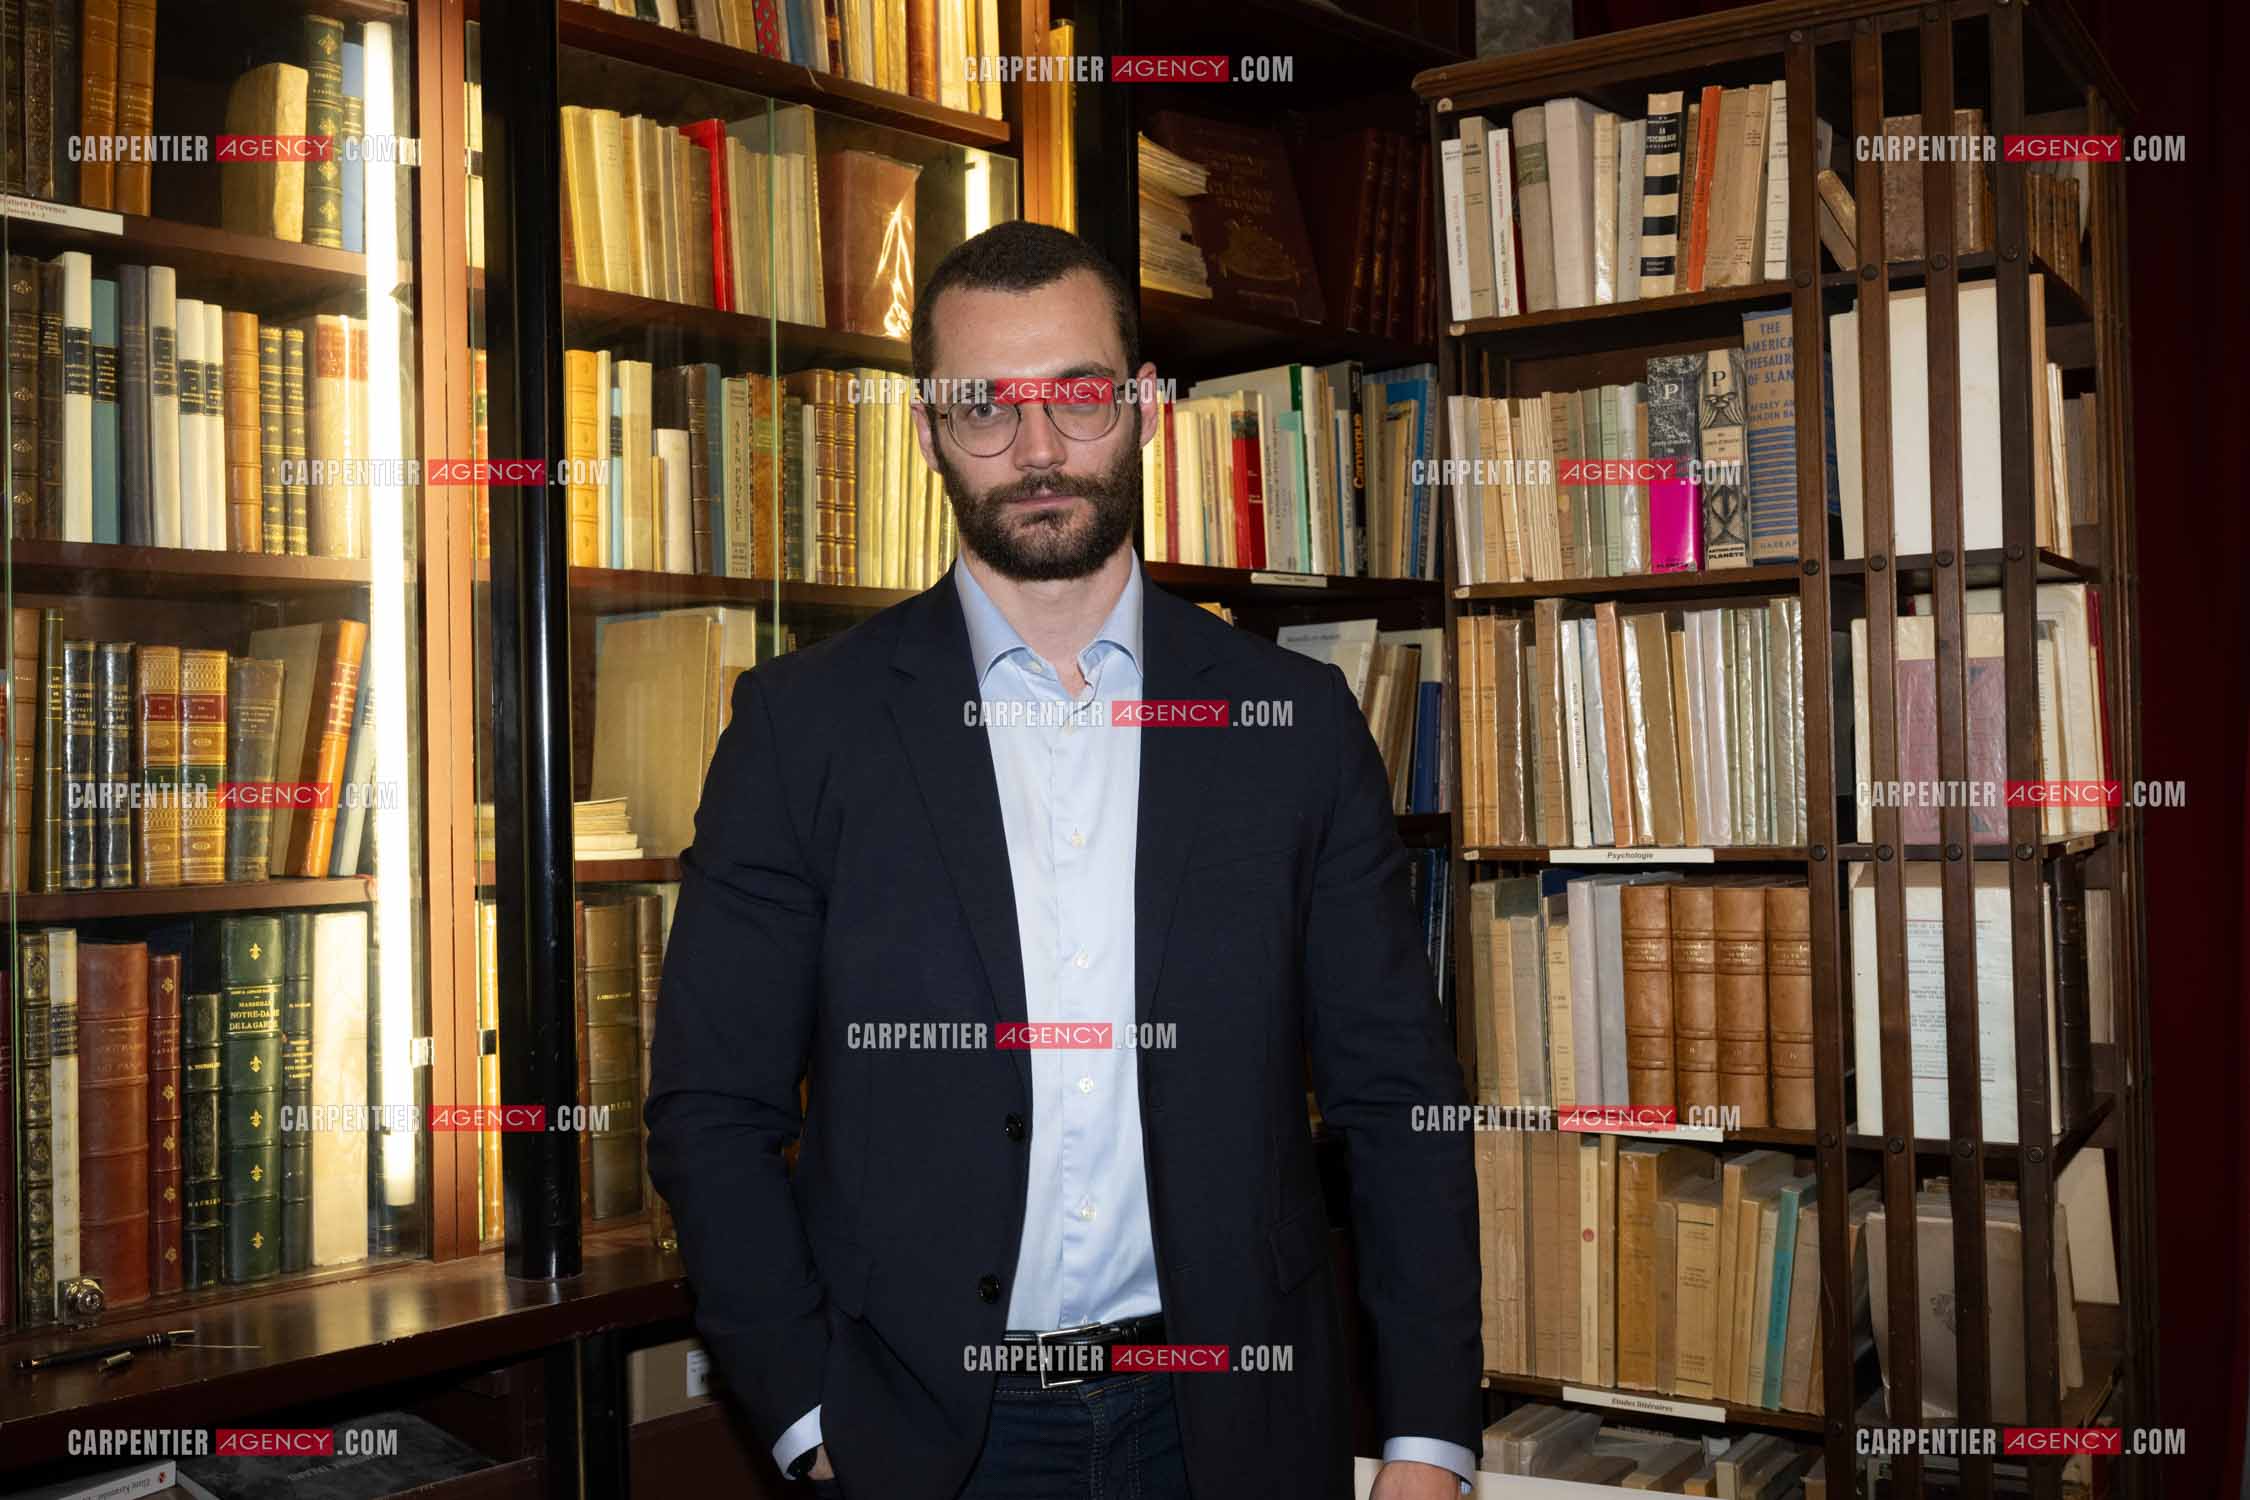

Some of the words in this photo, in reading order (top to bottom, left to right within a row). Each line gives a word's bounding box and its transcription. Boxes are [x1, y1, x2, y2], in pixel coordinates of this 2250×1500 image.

[1711, 370, 1726, 388] P
[1353, 413, 1365, 489] Camargue
[1608, 852, 1654, 861] Psychologie
